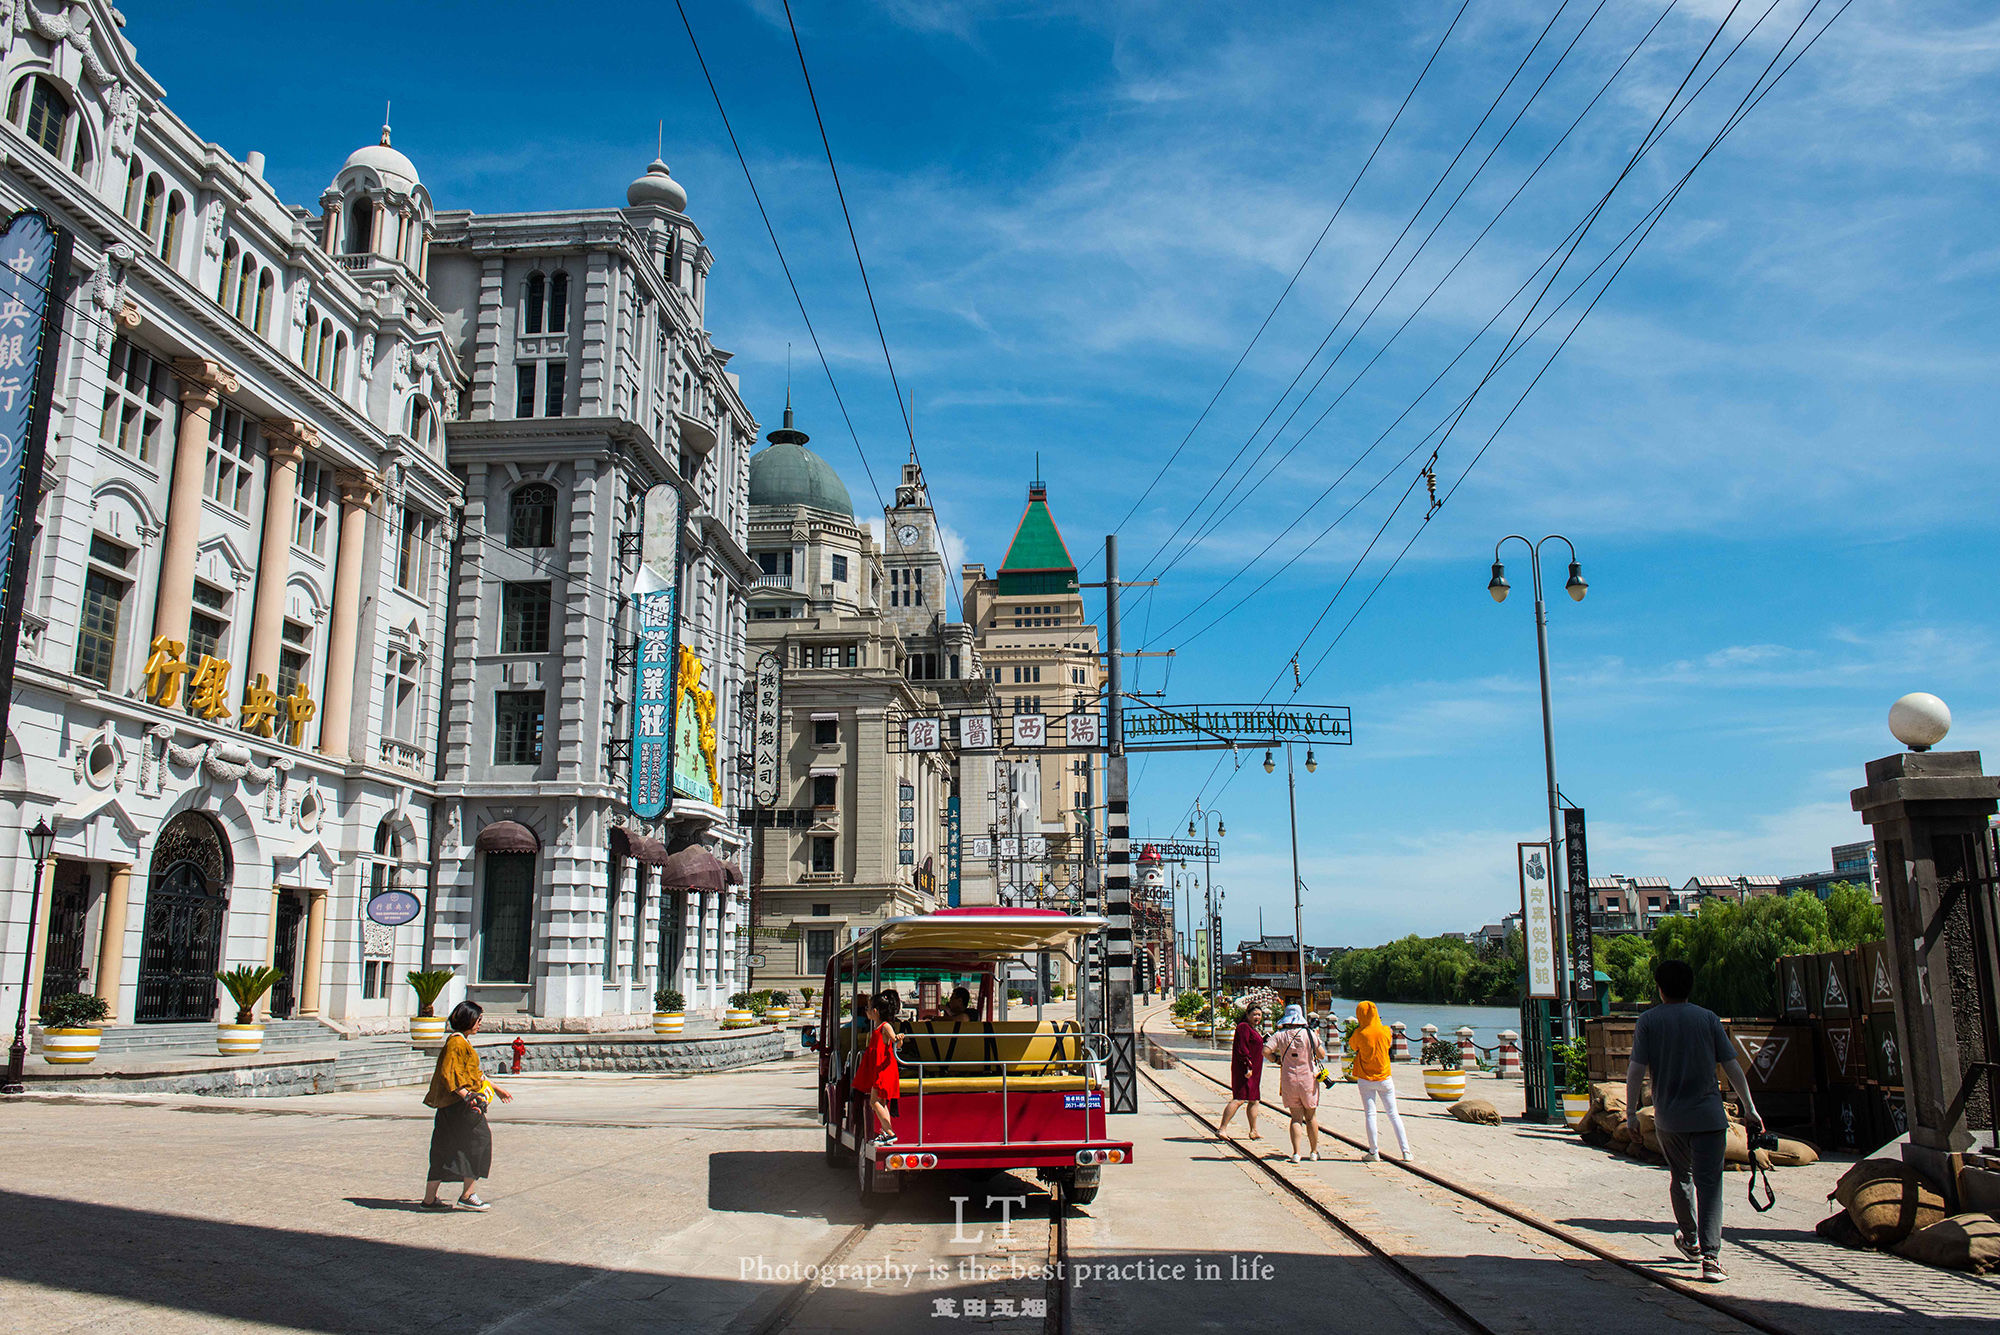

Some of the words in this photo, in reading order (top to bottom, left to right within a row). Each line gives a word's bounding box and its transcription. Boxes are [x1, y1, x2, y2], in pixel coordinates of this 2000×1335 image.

[758, 672, 776, 786] 旗昌輪船公司
[1129, 711, 1199, 738] JARDINE
[1205, 710, 1301, 735] MATHESON
[1305, 712, 1316, 735] &
[901, 786, 914, 863] DENT
